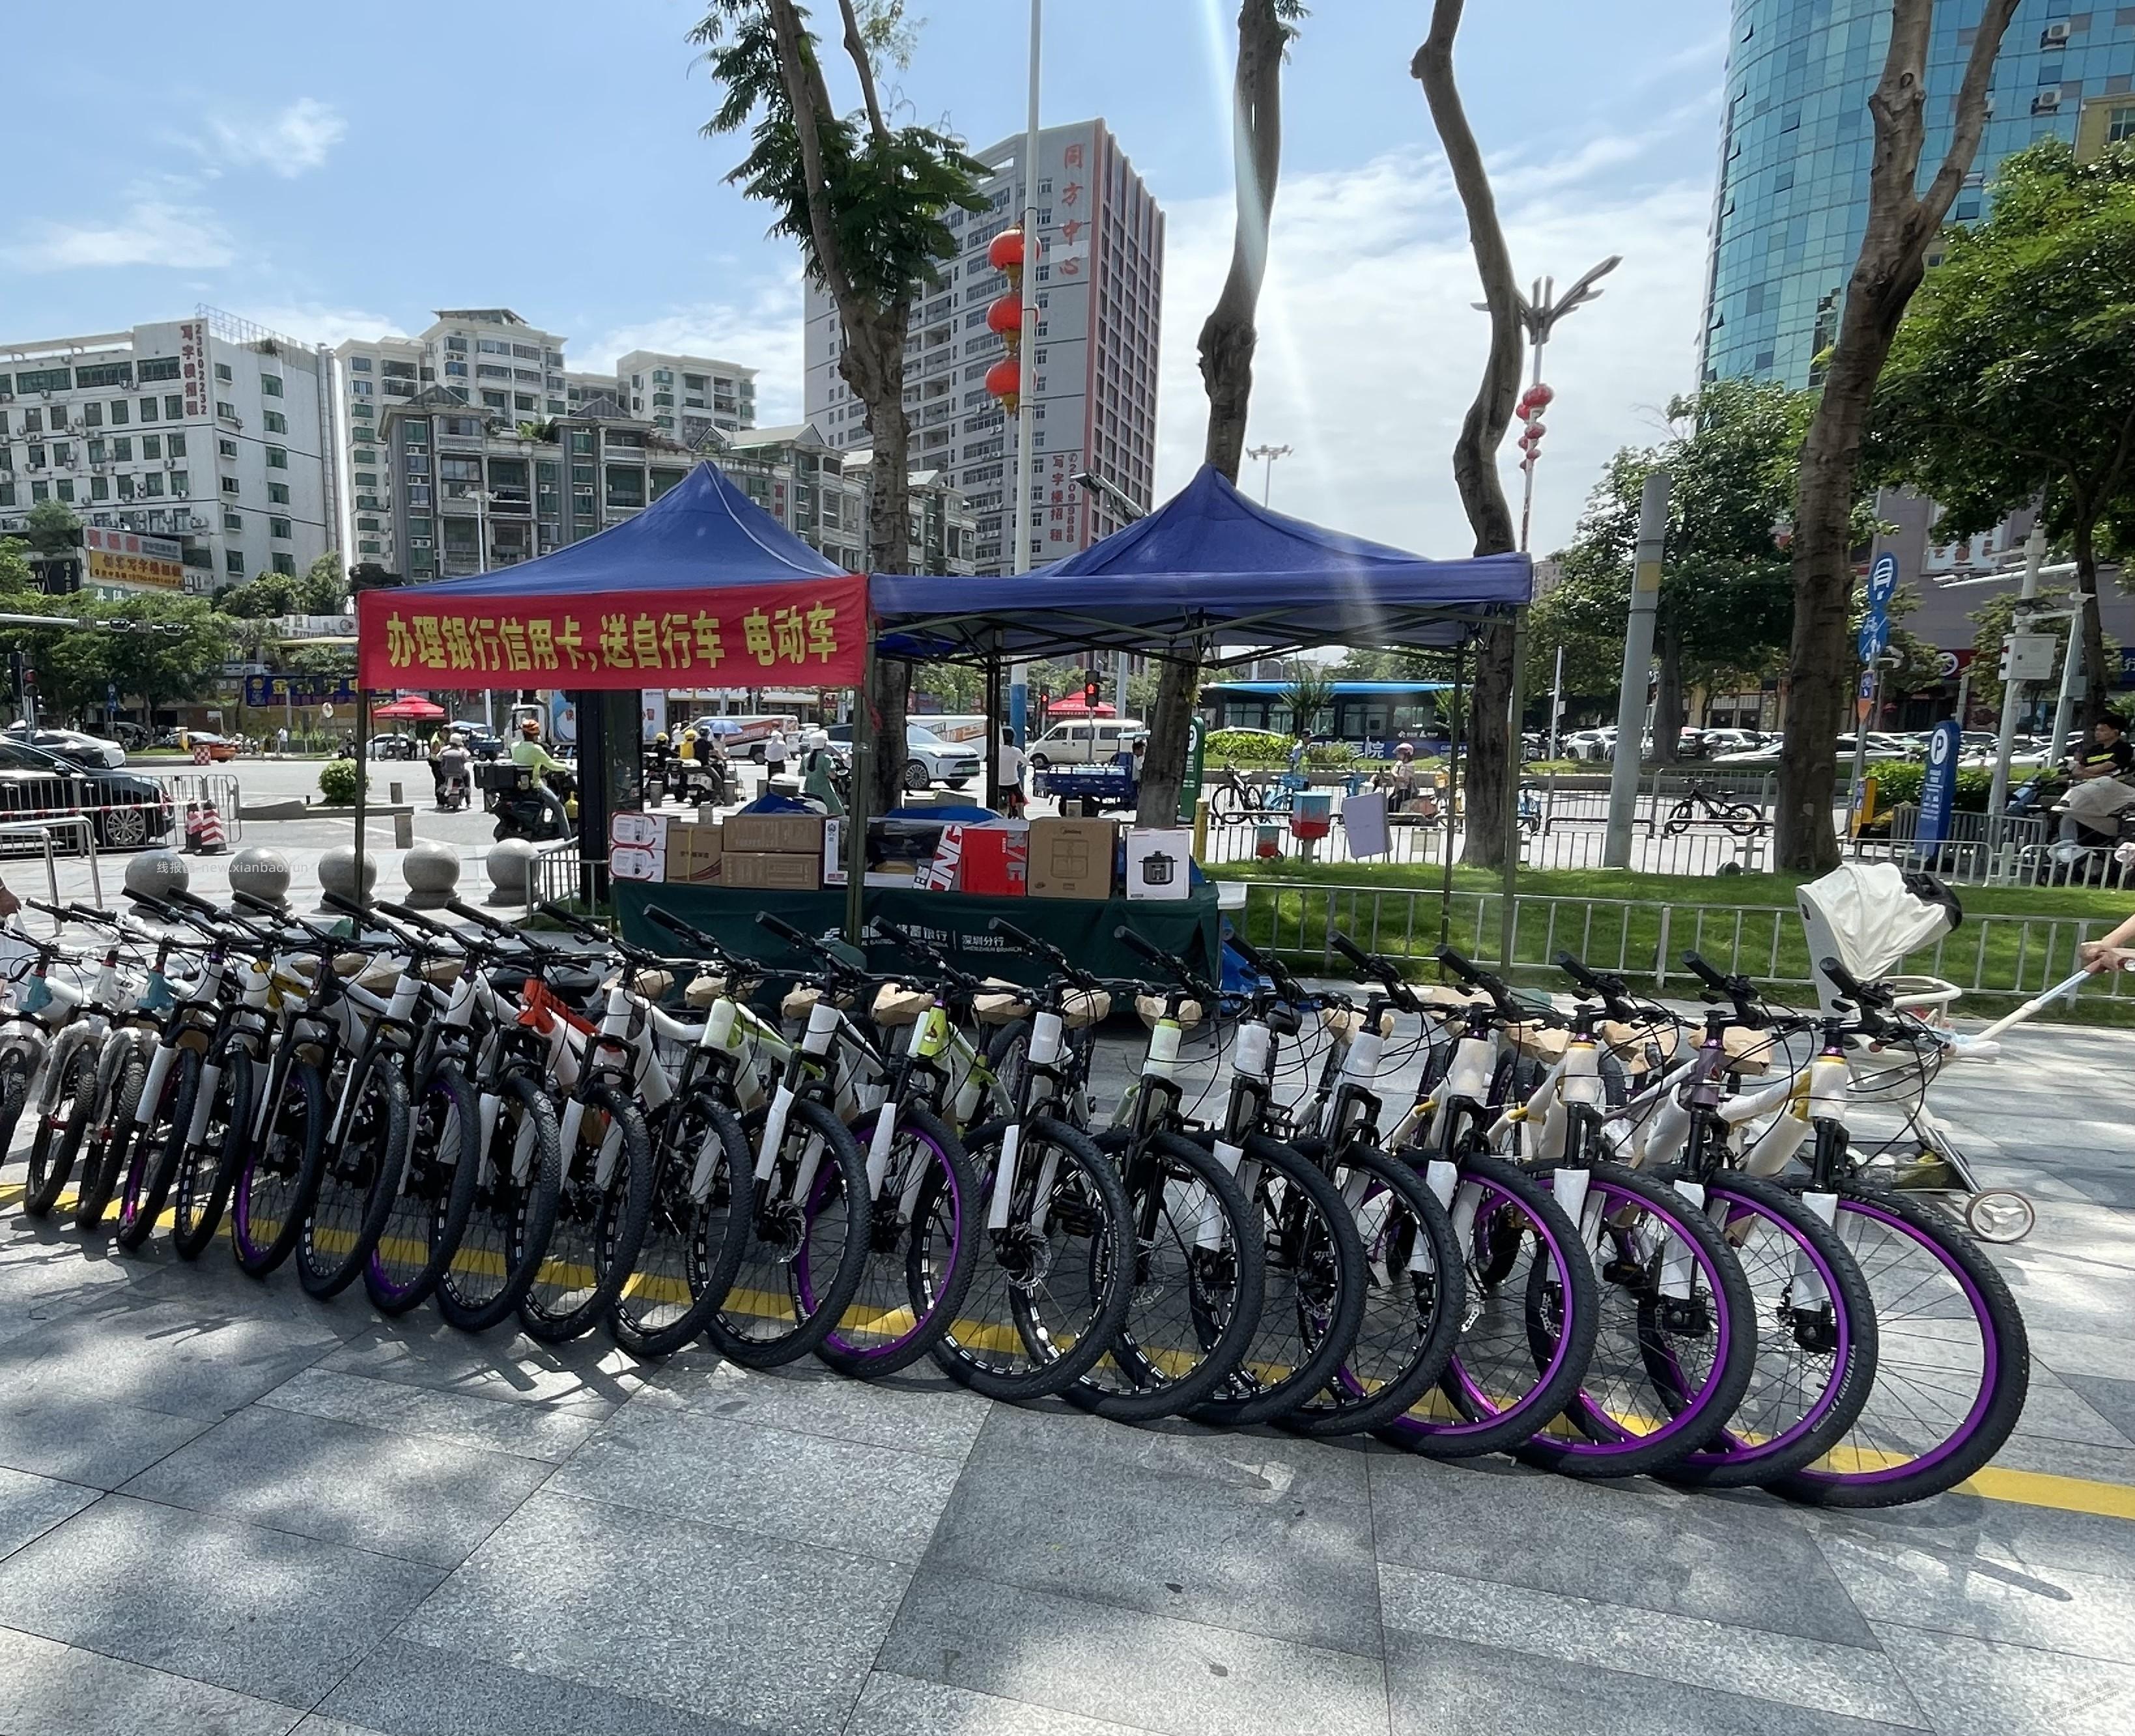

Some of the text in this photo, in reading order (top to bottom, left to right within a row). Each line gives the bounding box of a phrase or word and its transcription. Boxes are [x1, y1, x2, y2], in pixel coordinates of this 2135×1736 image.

[1050, 455, 1064, 542] 写字楼招租
[743, 600, 838, 666] 电动车
